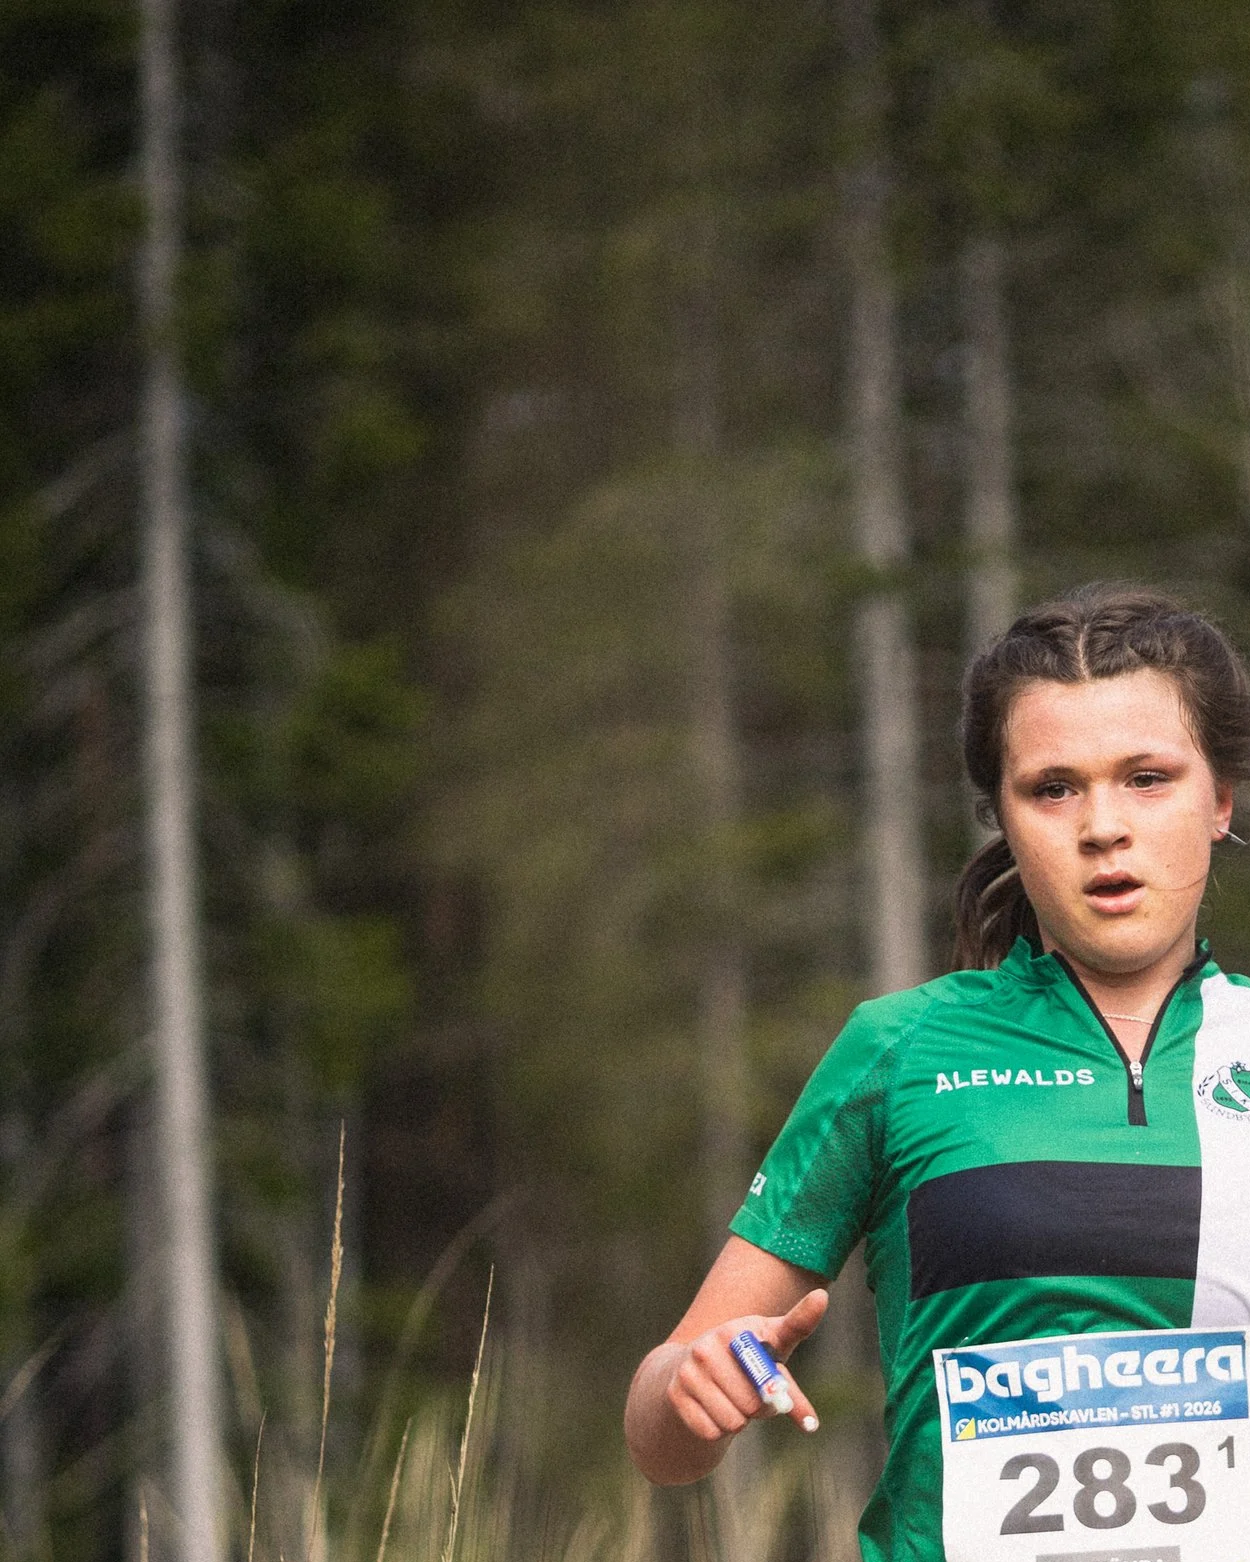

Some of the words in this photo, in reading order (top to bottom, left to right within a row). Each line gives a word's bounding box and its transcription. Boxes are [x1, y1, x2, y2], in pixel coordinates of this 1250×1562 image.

[935, 1068, 1095, 1094] ALEWALDS
[946, 1345, 1246, 1403] bagheera
[977, 1407, 1117, 1433] KOLMÅRDSKAVLEN
[1132, 1405, 1158, 1420] STL
[1160, 1403, 1179, 1418] #1
[1184, 1401, 1222, 1417] 2026
[1000, 1442, 1206, 1535] 283
